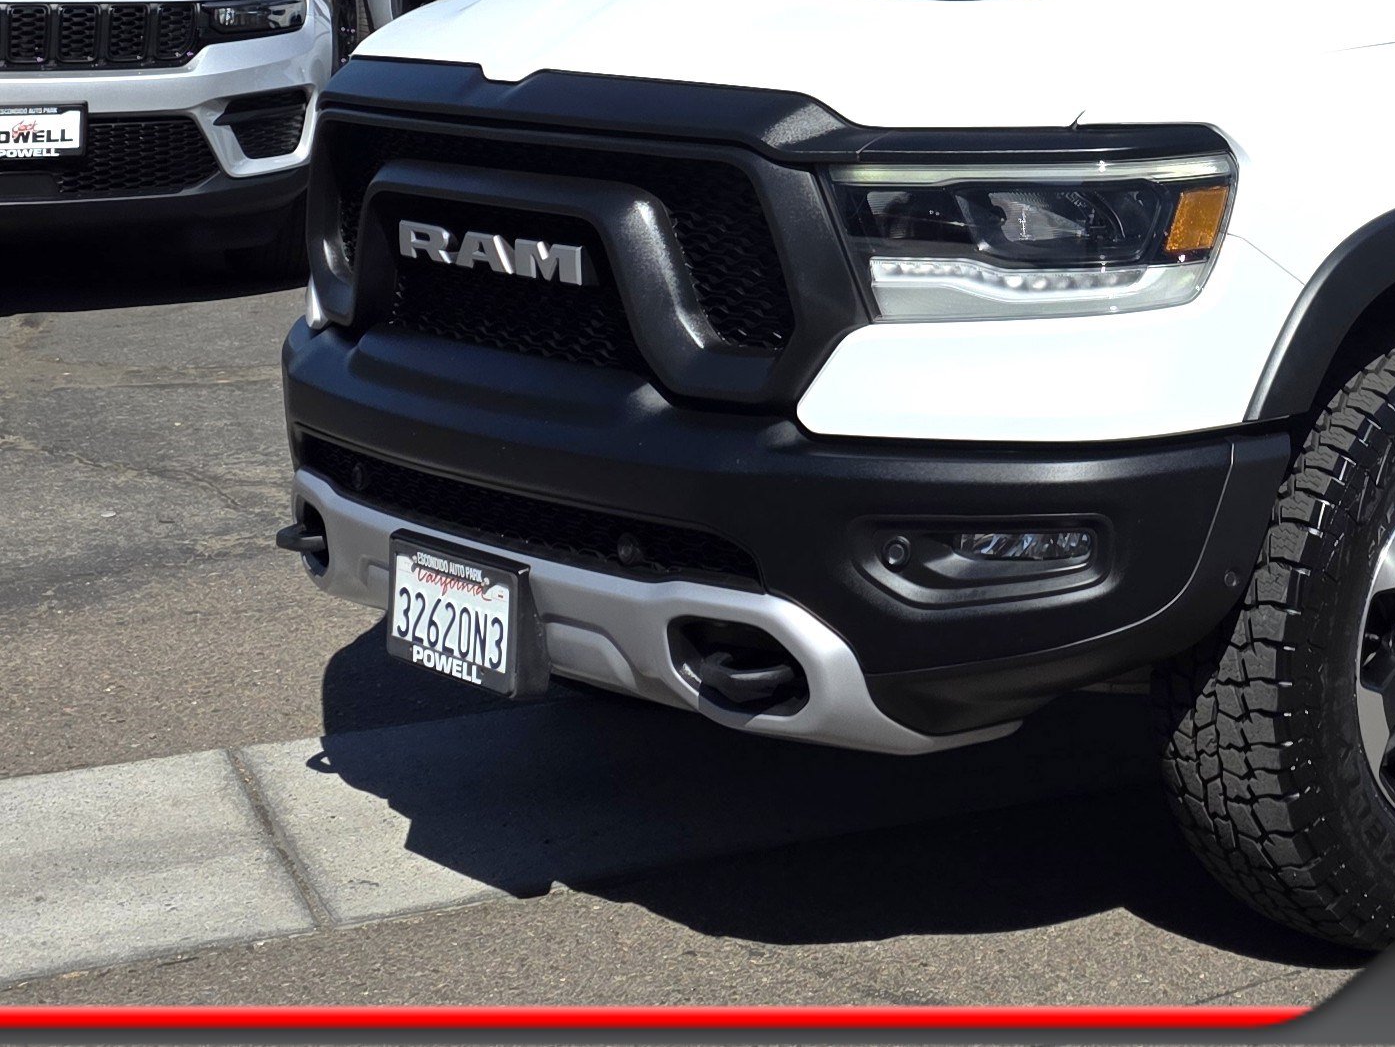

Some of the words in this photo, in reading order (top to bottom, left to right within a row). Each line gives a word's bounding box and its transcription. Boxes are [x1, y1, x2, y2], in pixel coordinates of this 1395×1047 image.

[0, 129, 73, 143] OWELL
[399, 220, 581, 285] RAM
[417, 552, 448, 574] ESCONDIDO
[449, 562, 464, 578] AUTO
[465, 567, 483, 583] PARK
[397, 587, 504, 669] 32620N3
[412, 645, 482, 684] POWELL
